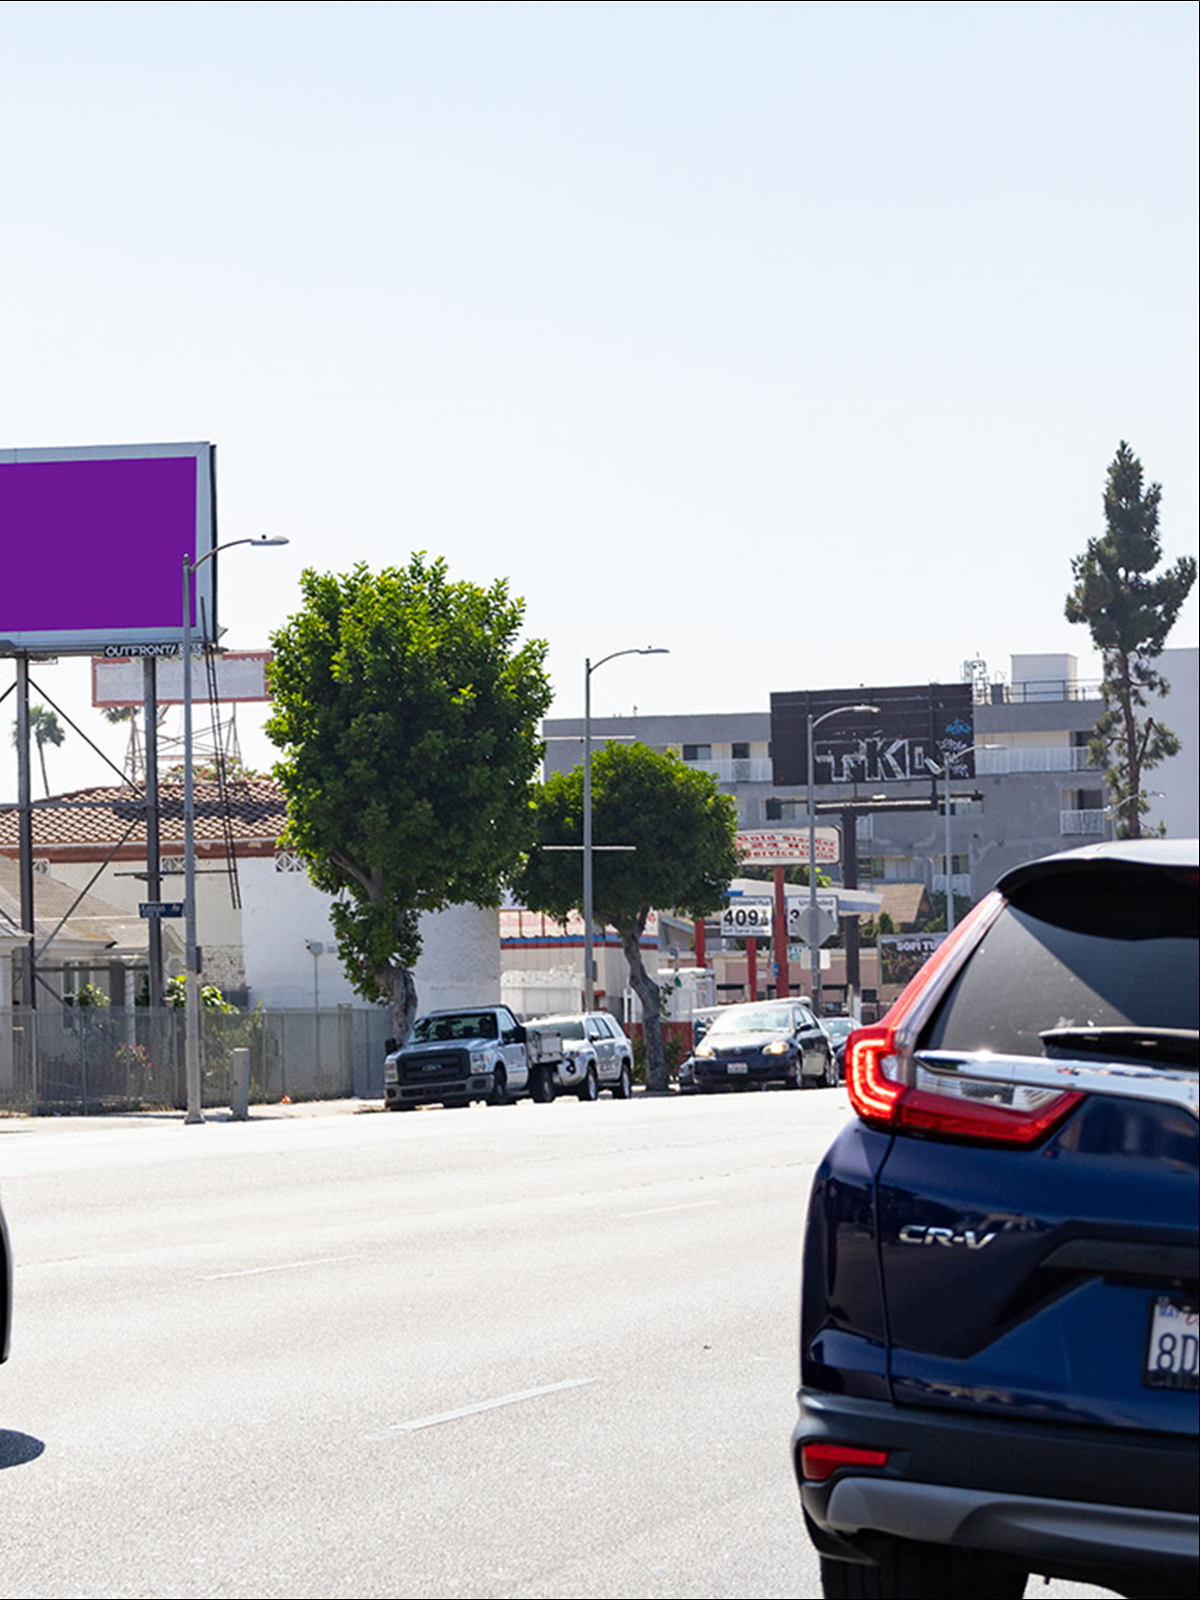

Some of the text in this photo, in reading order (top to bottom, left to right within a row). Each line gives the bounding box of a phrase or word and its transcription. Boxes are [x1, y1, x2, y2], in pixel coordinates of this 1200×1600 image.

[799, 850, 835, 859] Sttion
[723, 909, 759, 926] 409
[899, 1224, 997, 1249] CR-V
